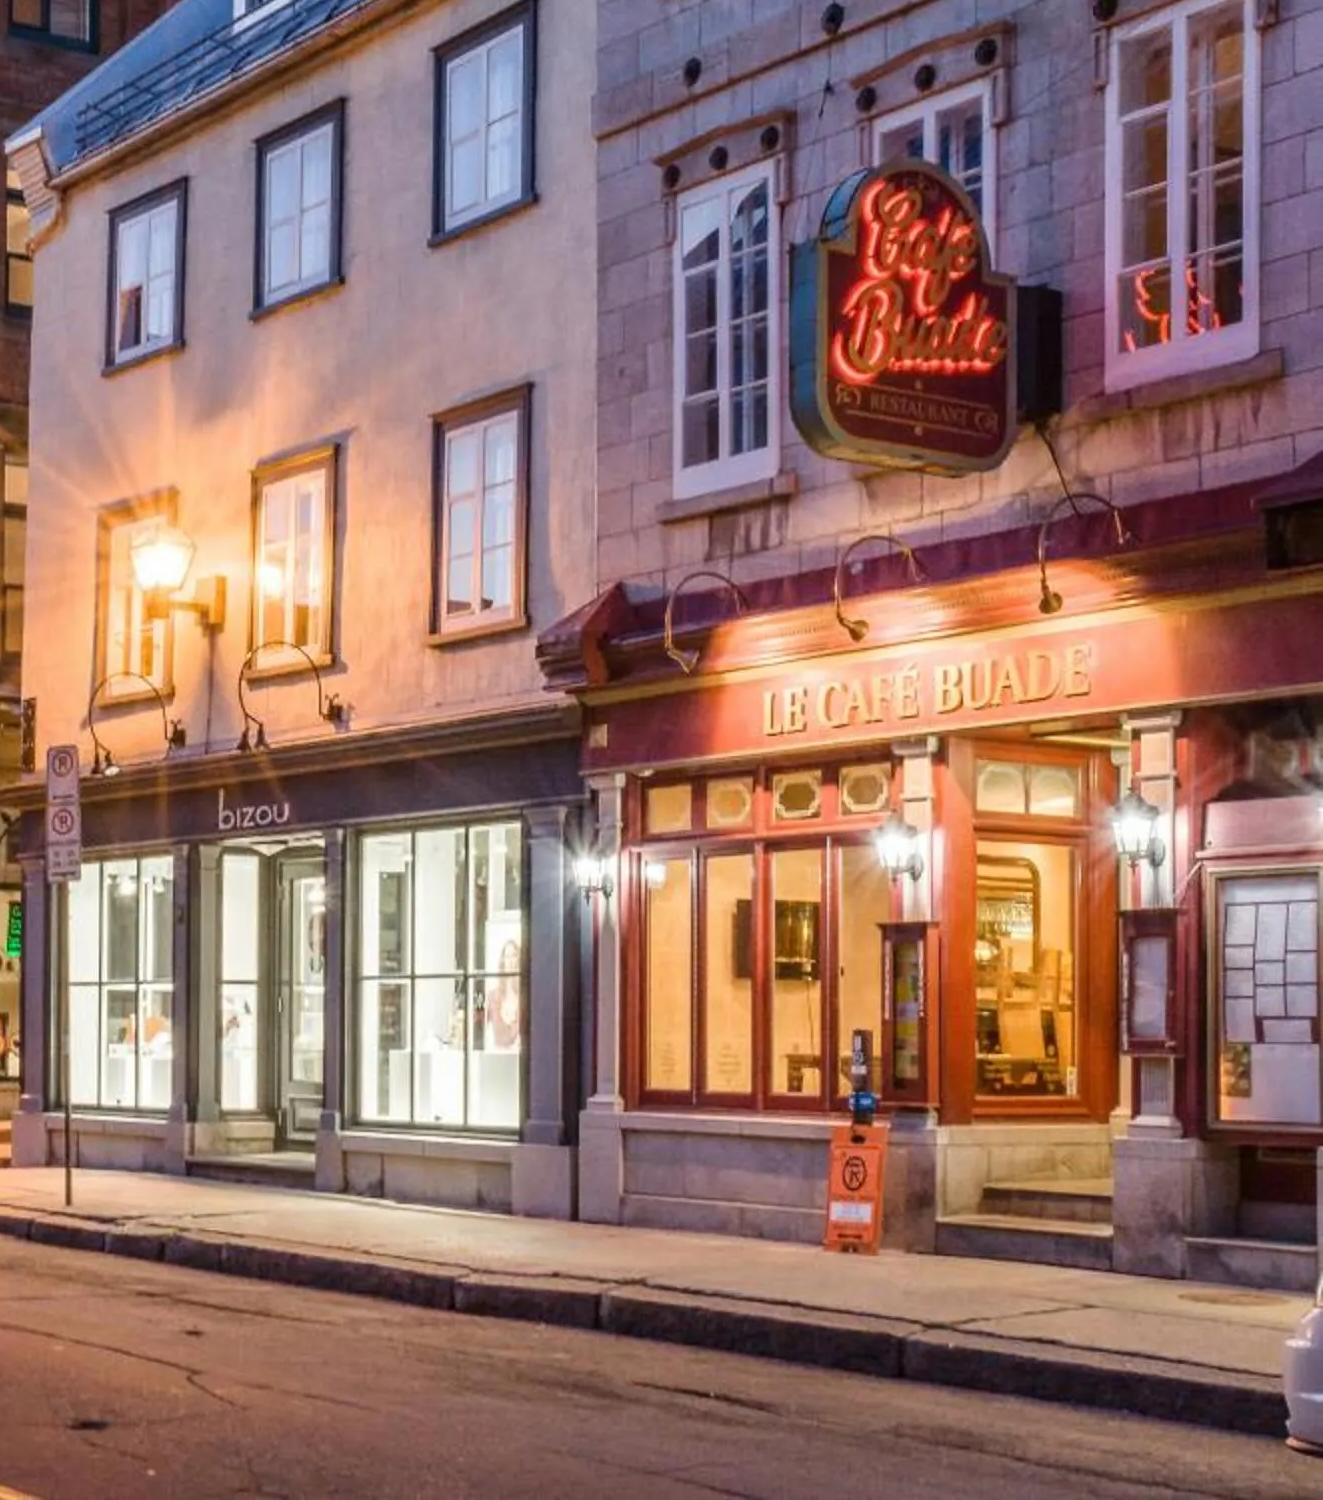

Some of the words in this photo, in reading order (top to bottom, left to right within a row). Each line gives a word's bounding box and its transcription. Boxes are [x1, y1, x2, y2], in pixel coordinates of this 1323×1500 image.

[833, 278, 1009, 385] Buade
[870, 392, 969, 427] RESTAURANT
[763, 686, 808, 736] LE
[816, 662, 919, 727] CAFÉ
[933, 643, 1093, 715] BUADE
[218, 787, 290, 829] bizou
